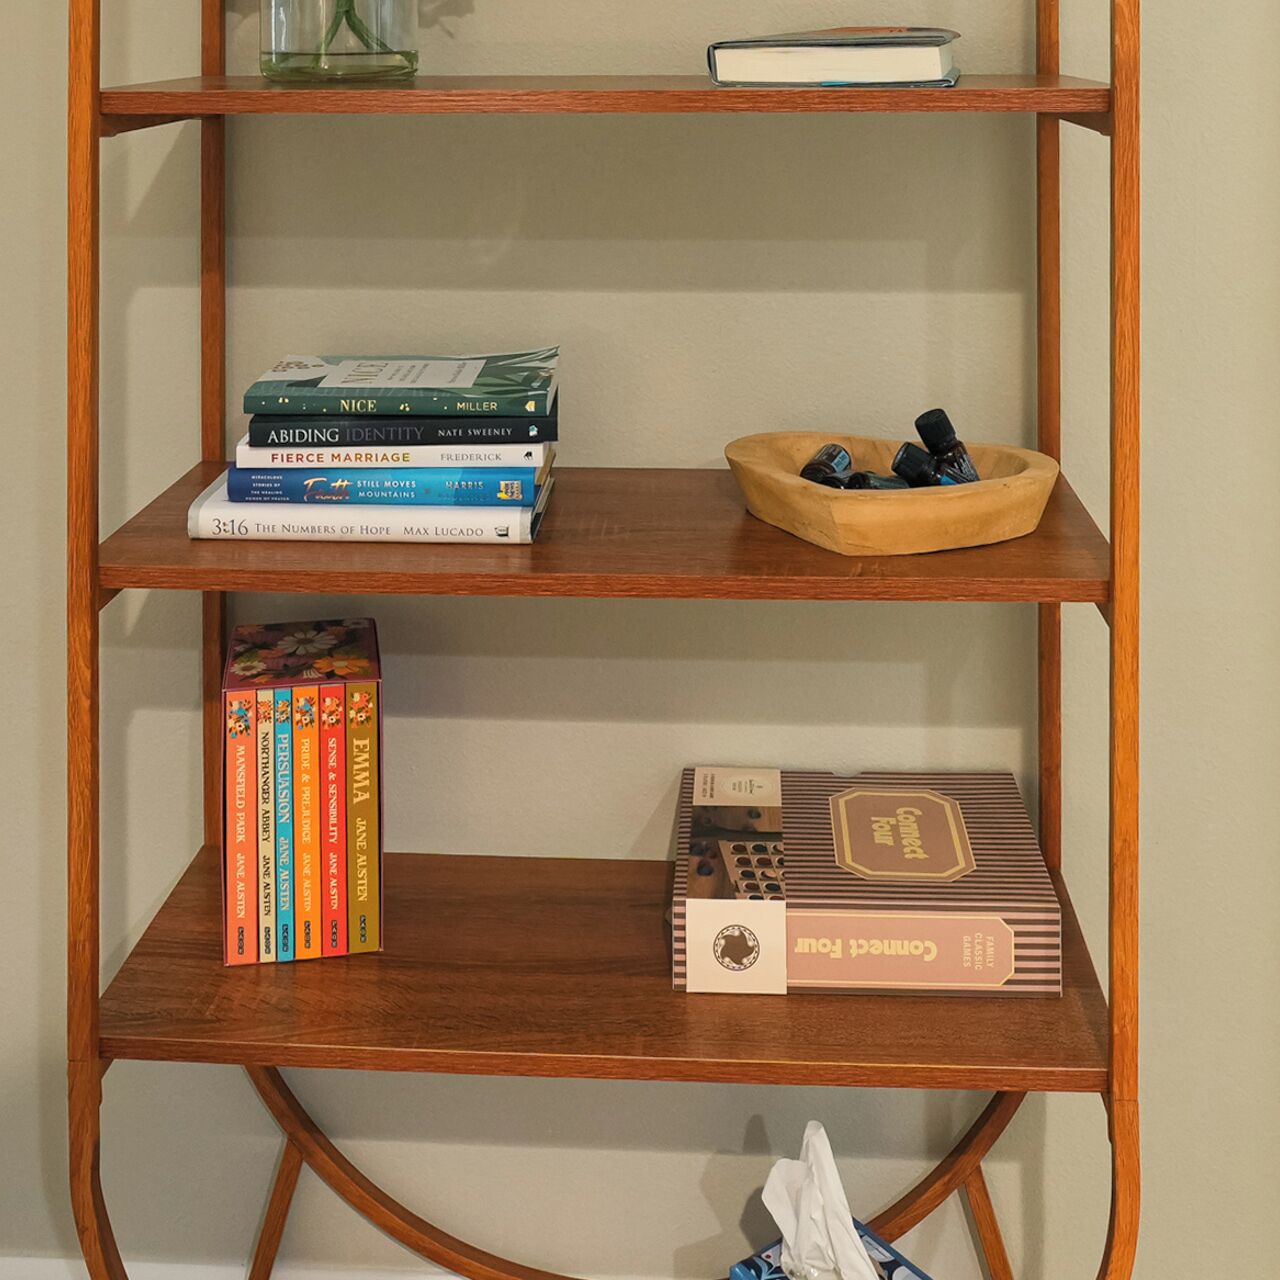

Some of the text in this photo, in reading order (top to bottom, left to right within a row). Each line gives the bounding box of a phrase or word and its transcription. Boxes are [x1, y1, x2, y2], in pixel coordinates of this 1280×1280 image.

[339, 399, 497, 413] NICE MILLER
[267, 426, 513, 444] ABIDING IDENTITY NATE SWEENEY
[271, 452, 502, 463] FIERCE MARRIAGE FREDERICK
[356, 480, 416, 488] STILL MOVES
[358, 490, 416, 498] MOUNTAINS
[445, 481, 484, 489] HARRIS
[211, 517, 249, 536] 3:16
[254, 523, 277, 533] THE
[281, 523, 336, 534] NUMBERS
[360, 525, 392, 535] HOPE
[403, 526, 429, 536] MAX
[435, 526, 484, 537] LUCADO
[235, 745, 246, 809] MANSFIELD
[261, 732, 270, 805] NORTHANGER
[235, 813, 246, 843] PARK
[261, 808, 271, 843] ABBEY
[277, 733, 290, 911] PERSUASION JANE AUSTEN
[301, 738, 312, 912] PRIDE & PREJUDICE JANE AUSTEN
[328, 737, 338, 910] SENSE & SENSIBILITY JANE AUSTEN
[353, 737, 370, 902] EMMA JANE AUSTEN
[870, 816, 897, 846] Four
[895, 807, 930, 860] Connect
[236, 852, 246, 878] JANE
[262, 855, 271, 880] JANE
[236, 880, 246, 919] AUSTEN
[263, 881, 271, 917] AUSTEN
[794, 937, 938, 962] Connect Four
[962, 935, 971, 968] GAMES
[974, 932, 983, 970] CLASSIC
[986, 936, 994, 968] FAMILY
